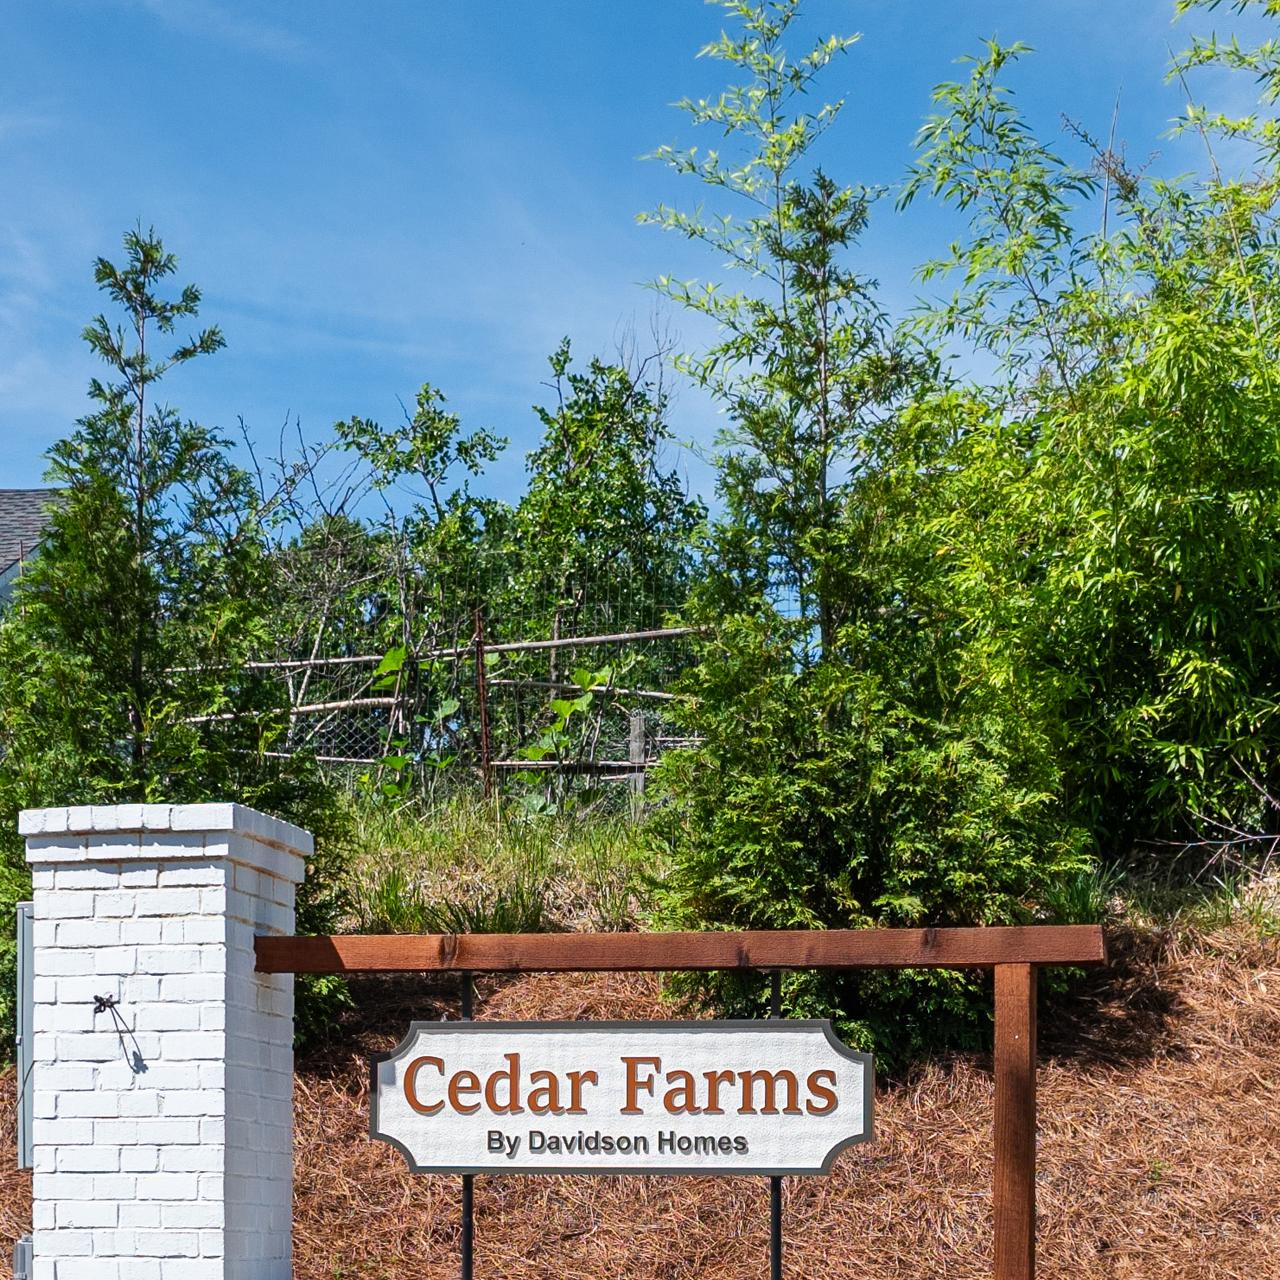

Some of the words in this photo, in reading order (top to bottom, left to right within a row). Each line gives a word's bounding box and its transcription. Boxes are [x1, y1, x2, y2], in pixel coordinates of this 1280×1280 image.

[403, 1053, 598, 1114] Cedar
[620, 1056, 838, 1115] Farms
[487, 1130, 519, 1156] By
[528, 1130, 648, 1153] Davidson
[658, 1131, 748, 1153] Homes
